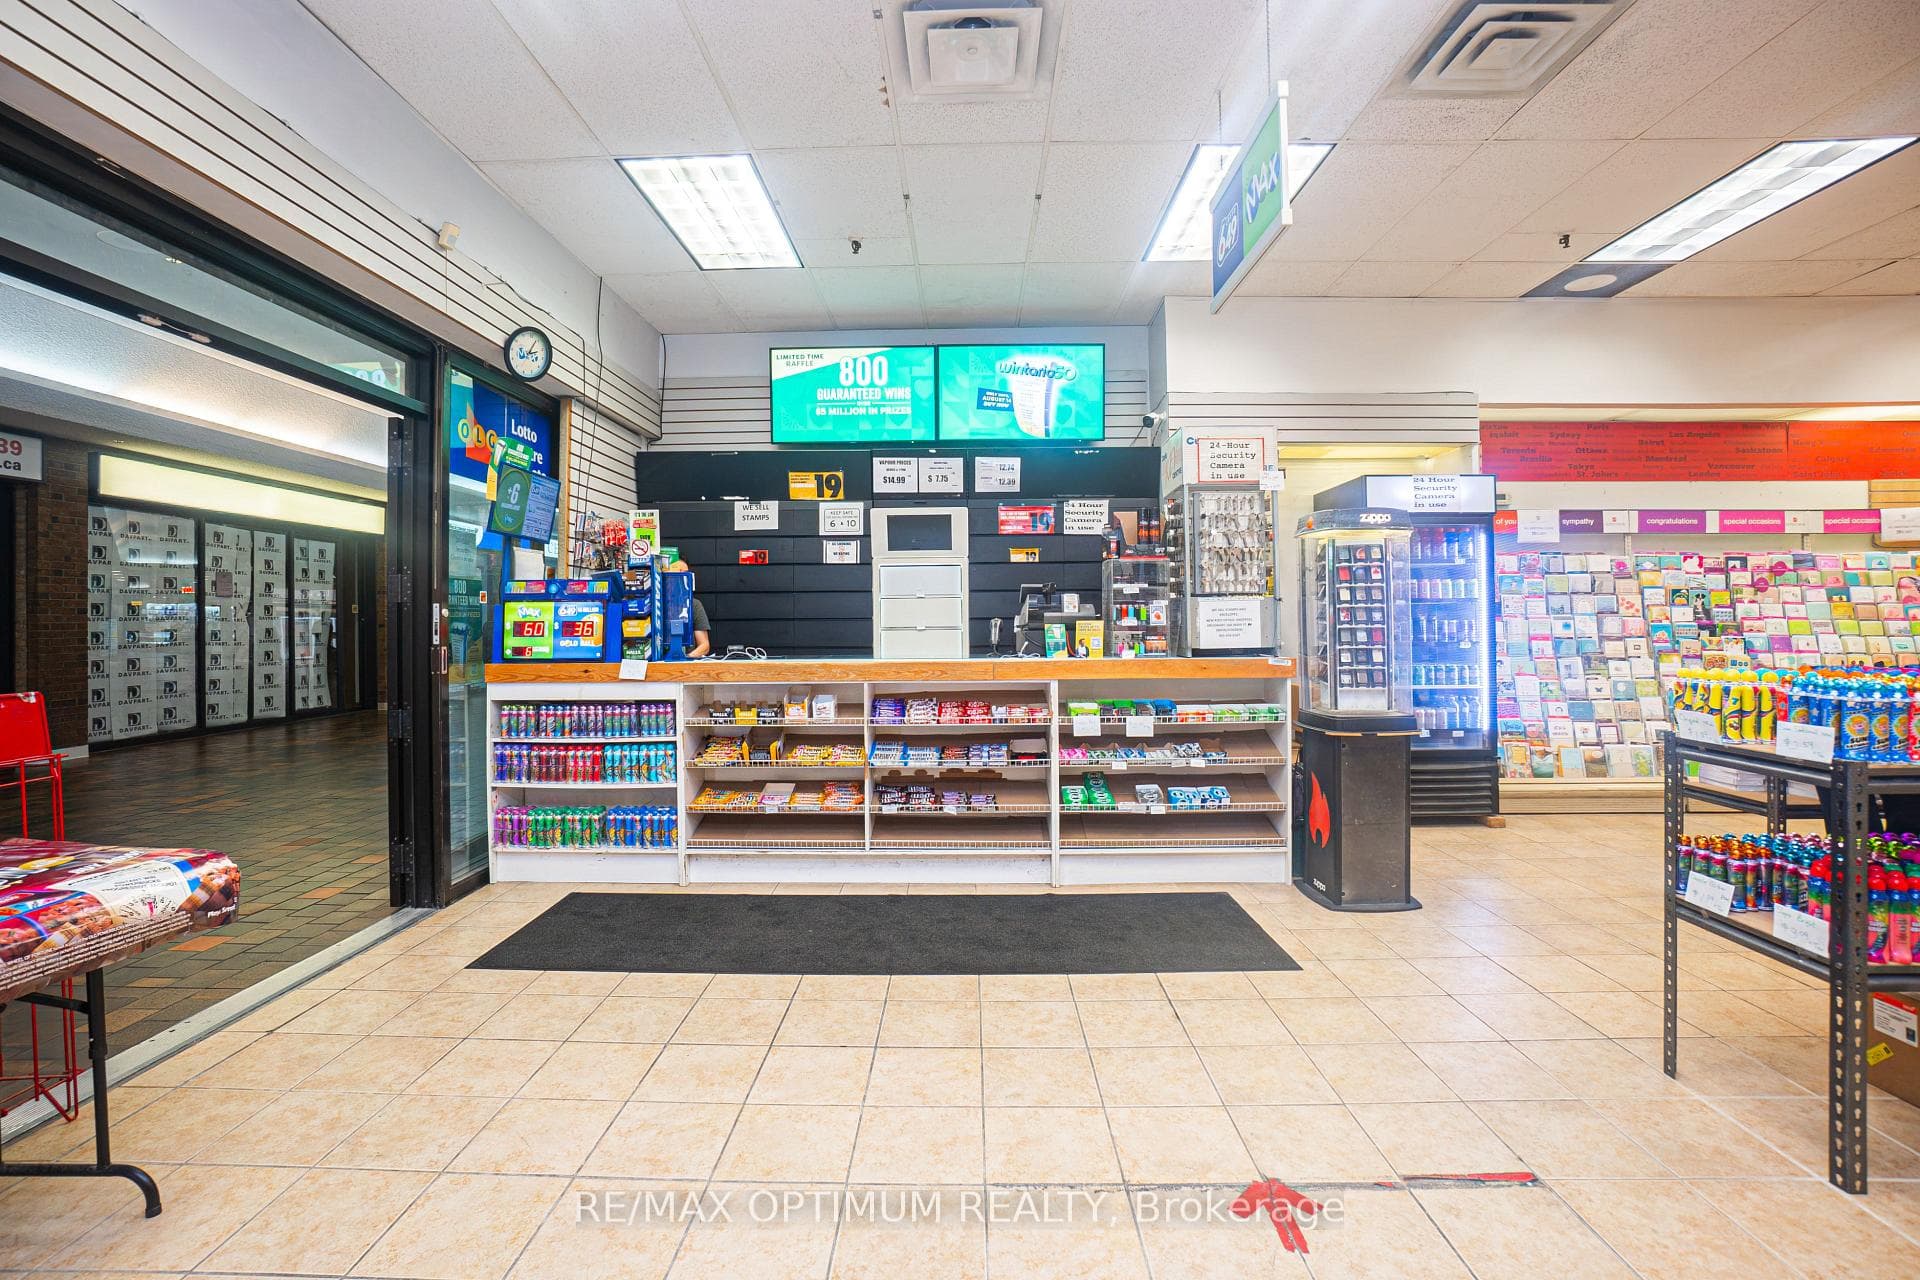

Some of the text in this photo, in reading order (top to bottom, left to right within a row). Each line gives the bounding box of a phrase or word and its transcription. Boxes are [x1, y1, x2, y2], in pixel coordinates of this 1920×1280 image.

[839, 356, 888, 386] 800
[816, 387, 911, 400] GUARANTEED WINS
[511, 418, 538, 443] Lotto
[815, 474, 842, 498] 19
[1562, 517, 1595, 526] sympathy
[1646, 517, 1698, 525] congratulations
[754, 552, 766, 563] 19
[1025, 552, 1036, 561] 19
[524, 622, 544, 636] 60
[574, 622, 593, 636] 36
[525, 646, 532, 656] 6
